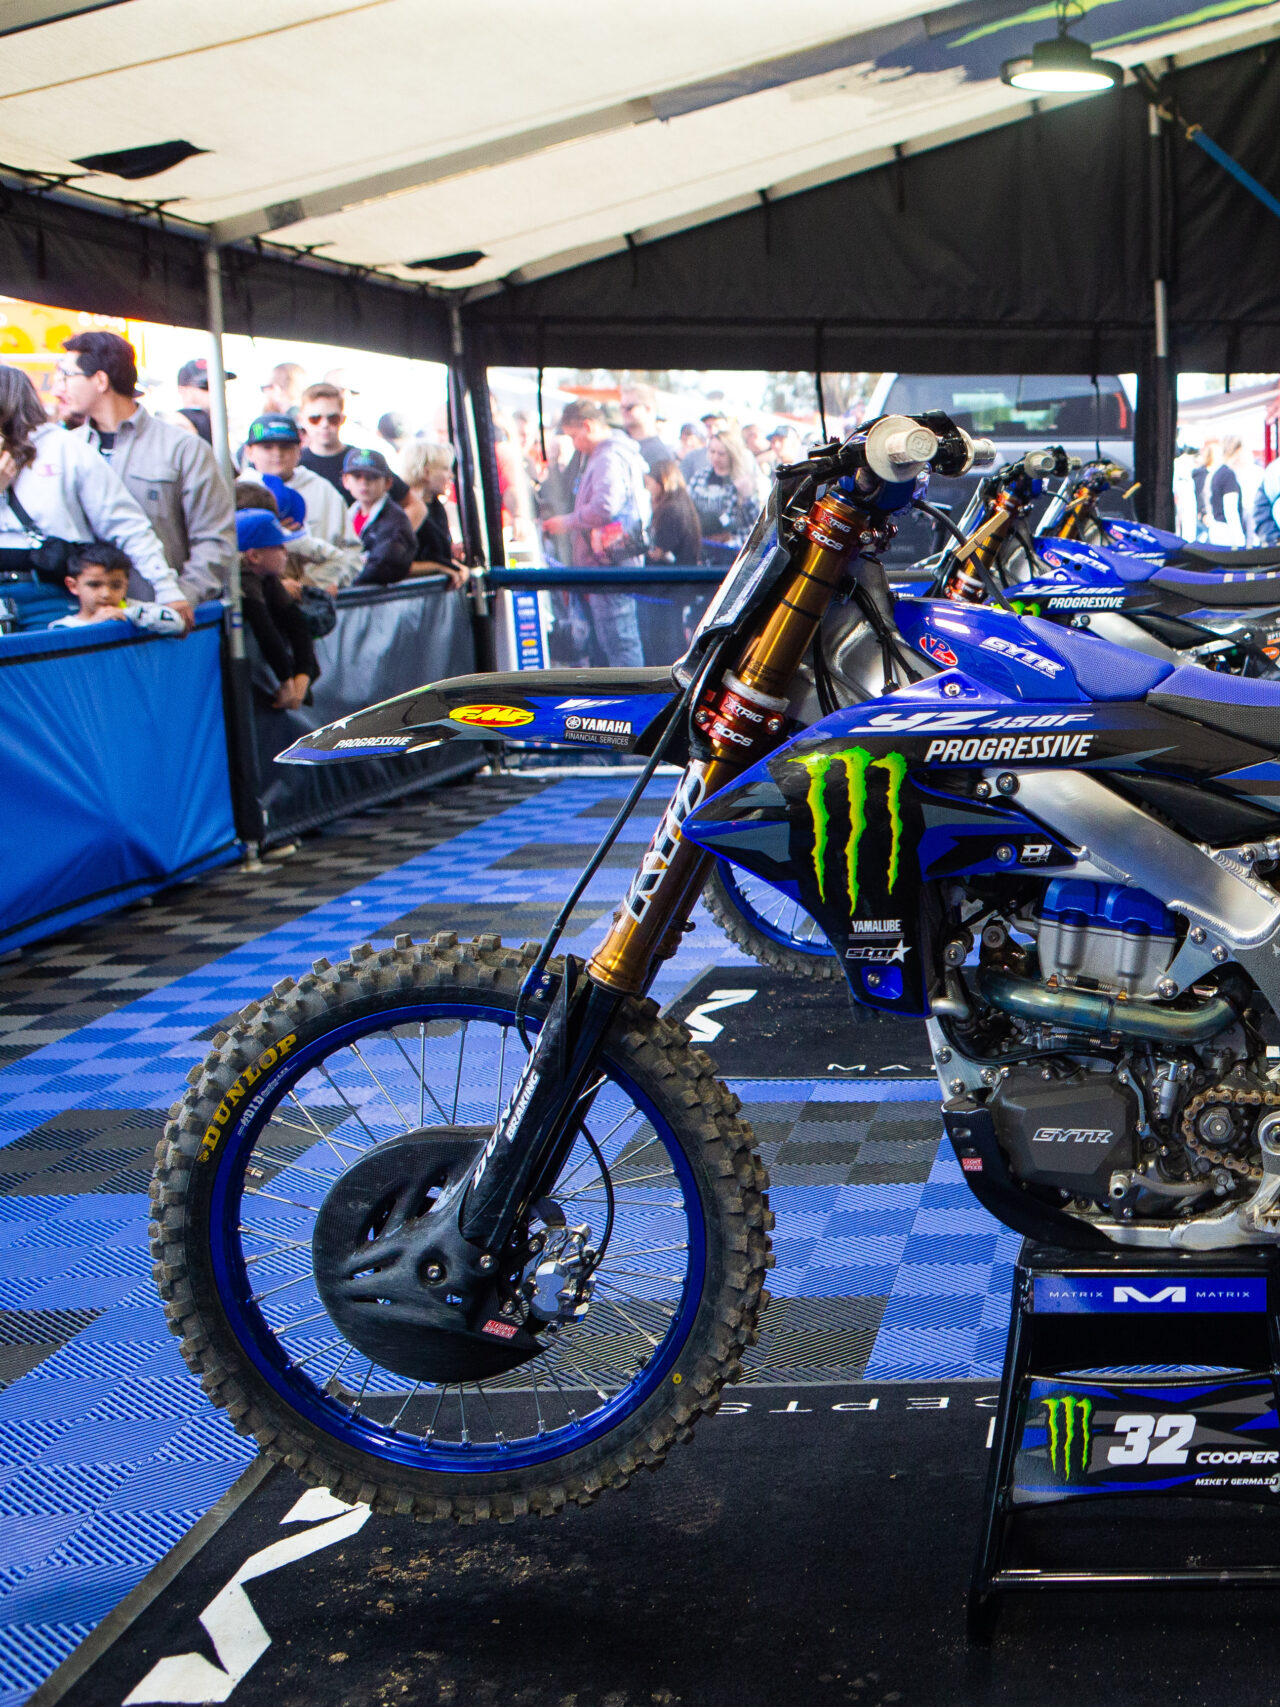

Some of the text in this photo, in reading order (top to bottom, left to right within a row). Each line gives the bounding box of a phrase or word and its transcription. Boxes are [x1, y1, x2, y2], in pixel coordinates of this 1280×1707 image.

[811, 530, 844, 551] ROCS
[1047, 597, 1126, 609] PROGRESSIVE
[924, 633, 951, 655] VP
[979, 636, 1065, 675] GYTR
[449, 707, 535, 722] FMF
[848, 710, 1095, 733] YZ 450F
[580, 719, 632, 735] YAMAHA
[713, 721, 753, 747] ROCS
[332, 736, 414, 750] PROGRESSIVE
[565, 731, 629, 746] FINANCIAL SERVICES
[924, 734, 1094, 763] PROGRESSIVE
[852, 919, 902, 933] YAMALUBE
[202, 1034, 297, 1151] DUNLOP
[505, 1068, 541, 1144] BRAKING
[1033, 1128, 1114, 1143] GYTR
[483, 1327, 514, 1338] SPEED
[488, 1320, 519, 1333] LIGHT
[1107, 1414, 1197, 1465] 32
[1196, 1451, 1280, 1465] COOPER
[1195, 1477, 1276, 1487] MIKEY GERMAIN
